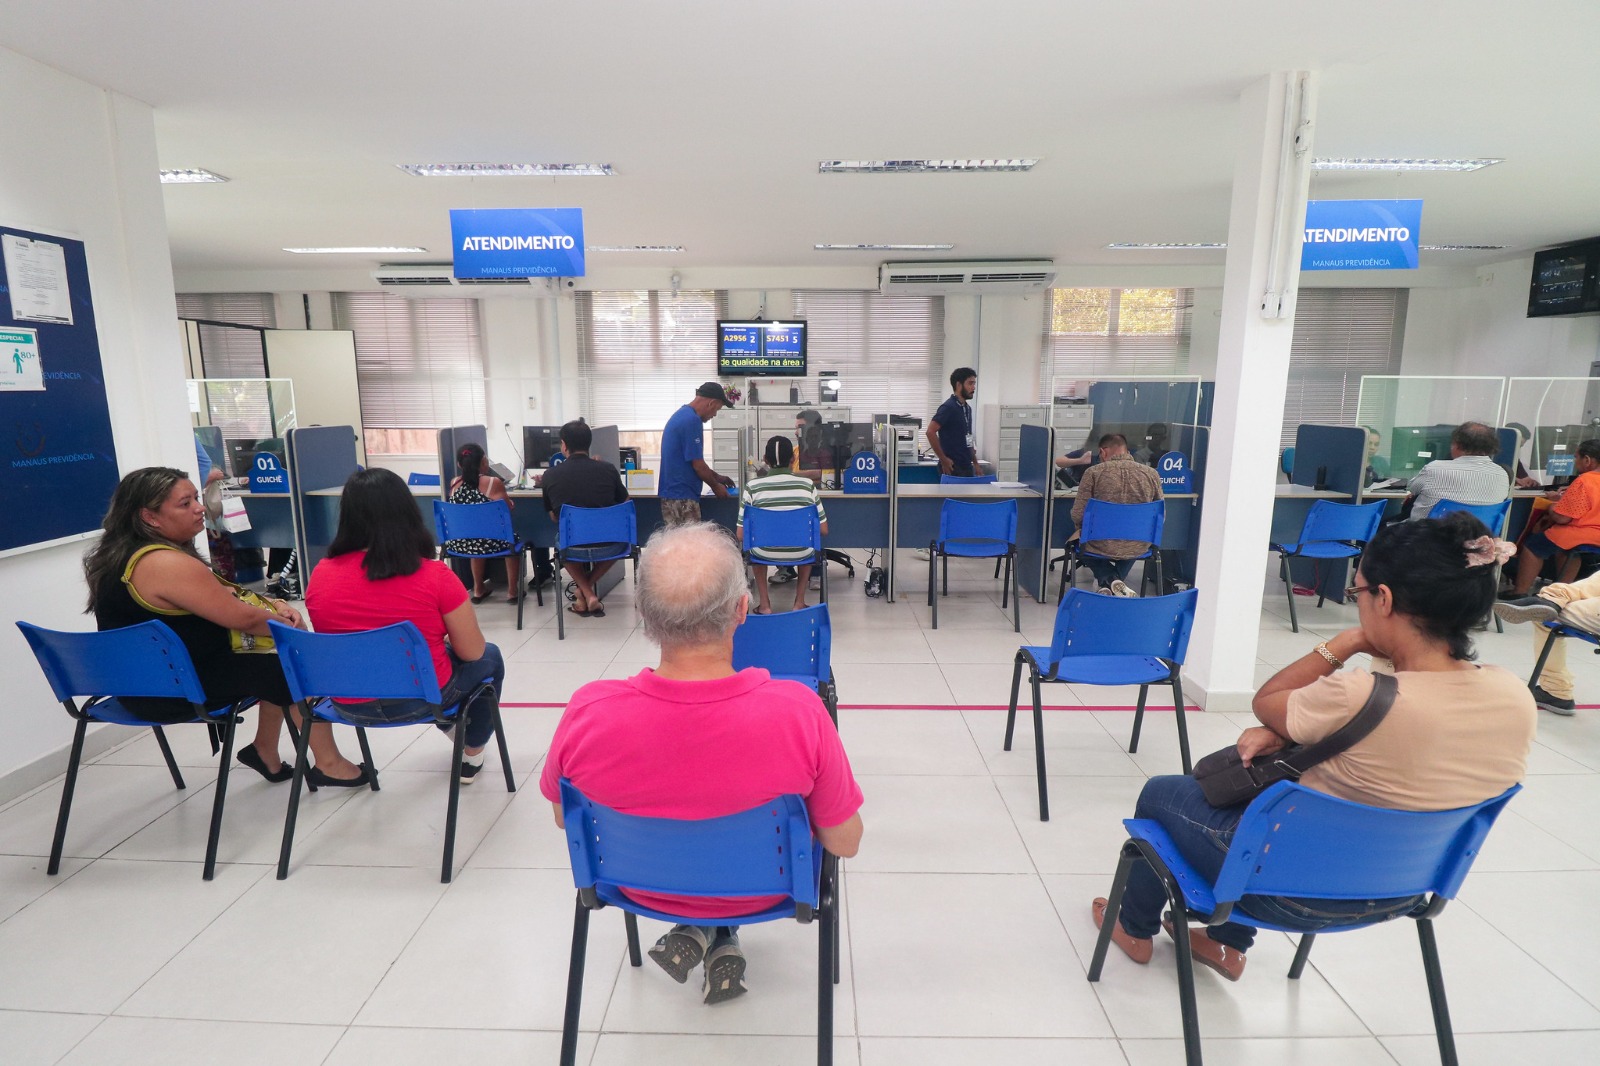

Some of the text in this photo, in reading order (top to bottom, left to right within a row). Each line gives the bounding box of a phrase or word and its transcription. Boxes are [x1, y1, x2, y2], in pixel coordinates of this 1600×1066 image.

[462, 235, 575, 251] ATENDIMENTO
[1345, 257, 1391, 267] PREVIDÊNCIA
[481, 265, 558, 274] MANAUS PREVIDÊNCIA
[750, 336, 756, 344] 2
[20, 351, 36, 359] 80+
[721, 358, 730, 366] de
[732, 358, 769, 367] qualidade
[783, 358, 800, 366] área
[43, 370, 82, 380] EVIDÊNCIA
[12, 453, 95, 468] MANAUS PREVIDÊNCIA
[257, 457, 277, 470] 01
[856, 457, 875, 470] 03
[1163, 457, 1183, 471] 04
[256, 475, 283, 483] GUICHÊ
[852, 475, 879, 483] GUICHÊ
